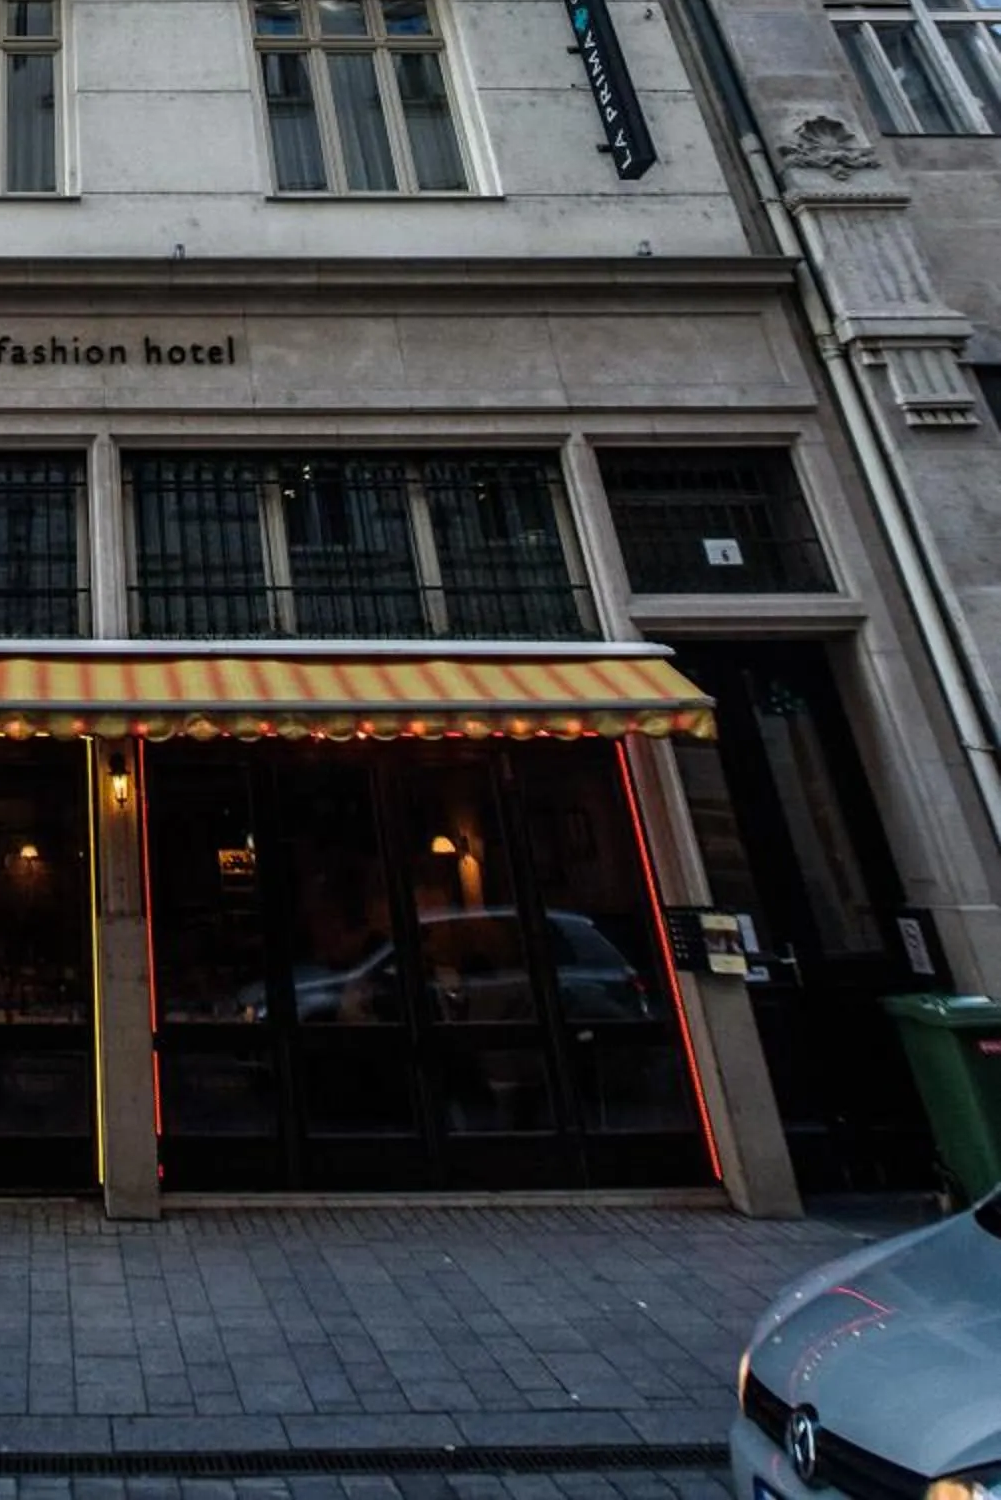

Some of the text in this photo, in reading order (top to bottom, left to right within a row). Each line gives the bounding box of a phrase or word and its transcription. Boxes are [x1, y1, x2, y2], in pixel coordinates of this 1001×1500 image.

[583, 29, 619, 123] PRIMA
[614, 127, 632, 170] LA
[144, 335, 236, 366] hotel
